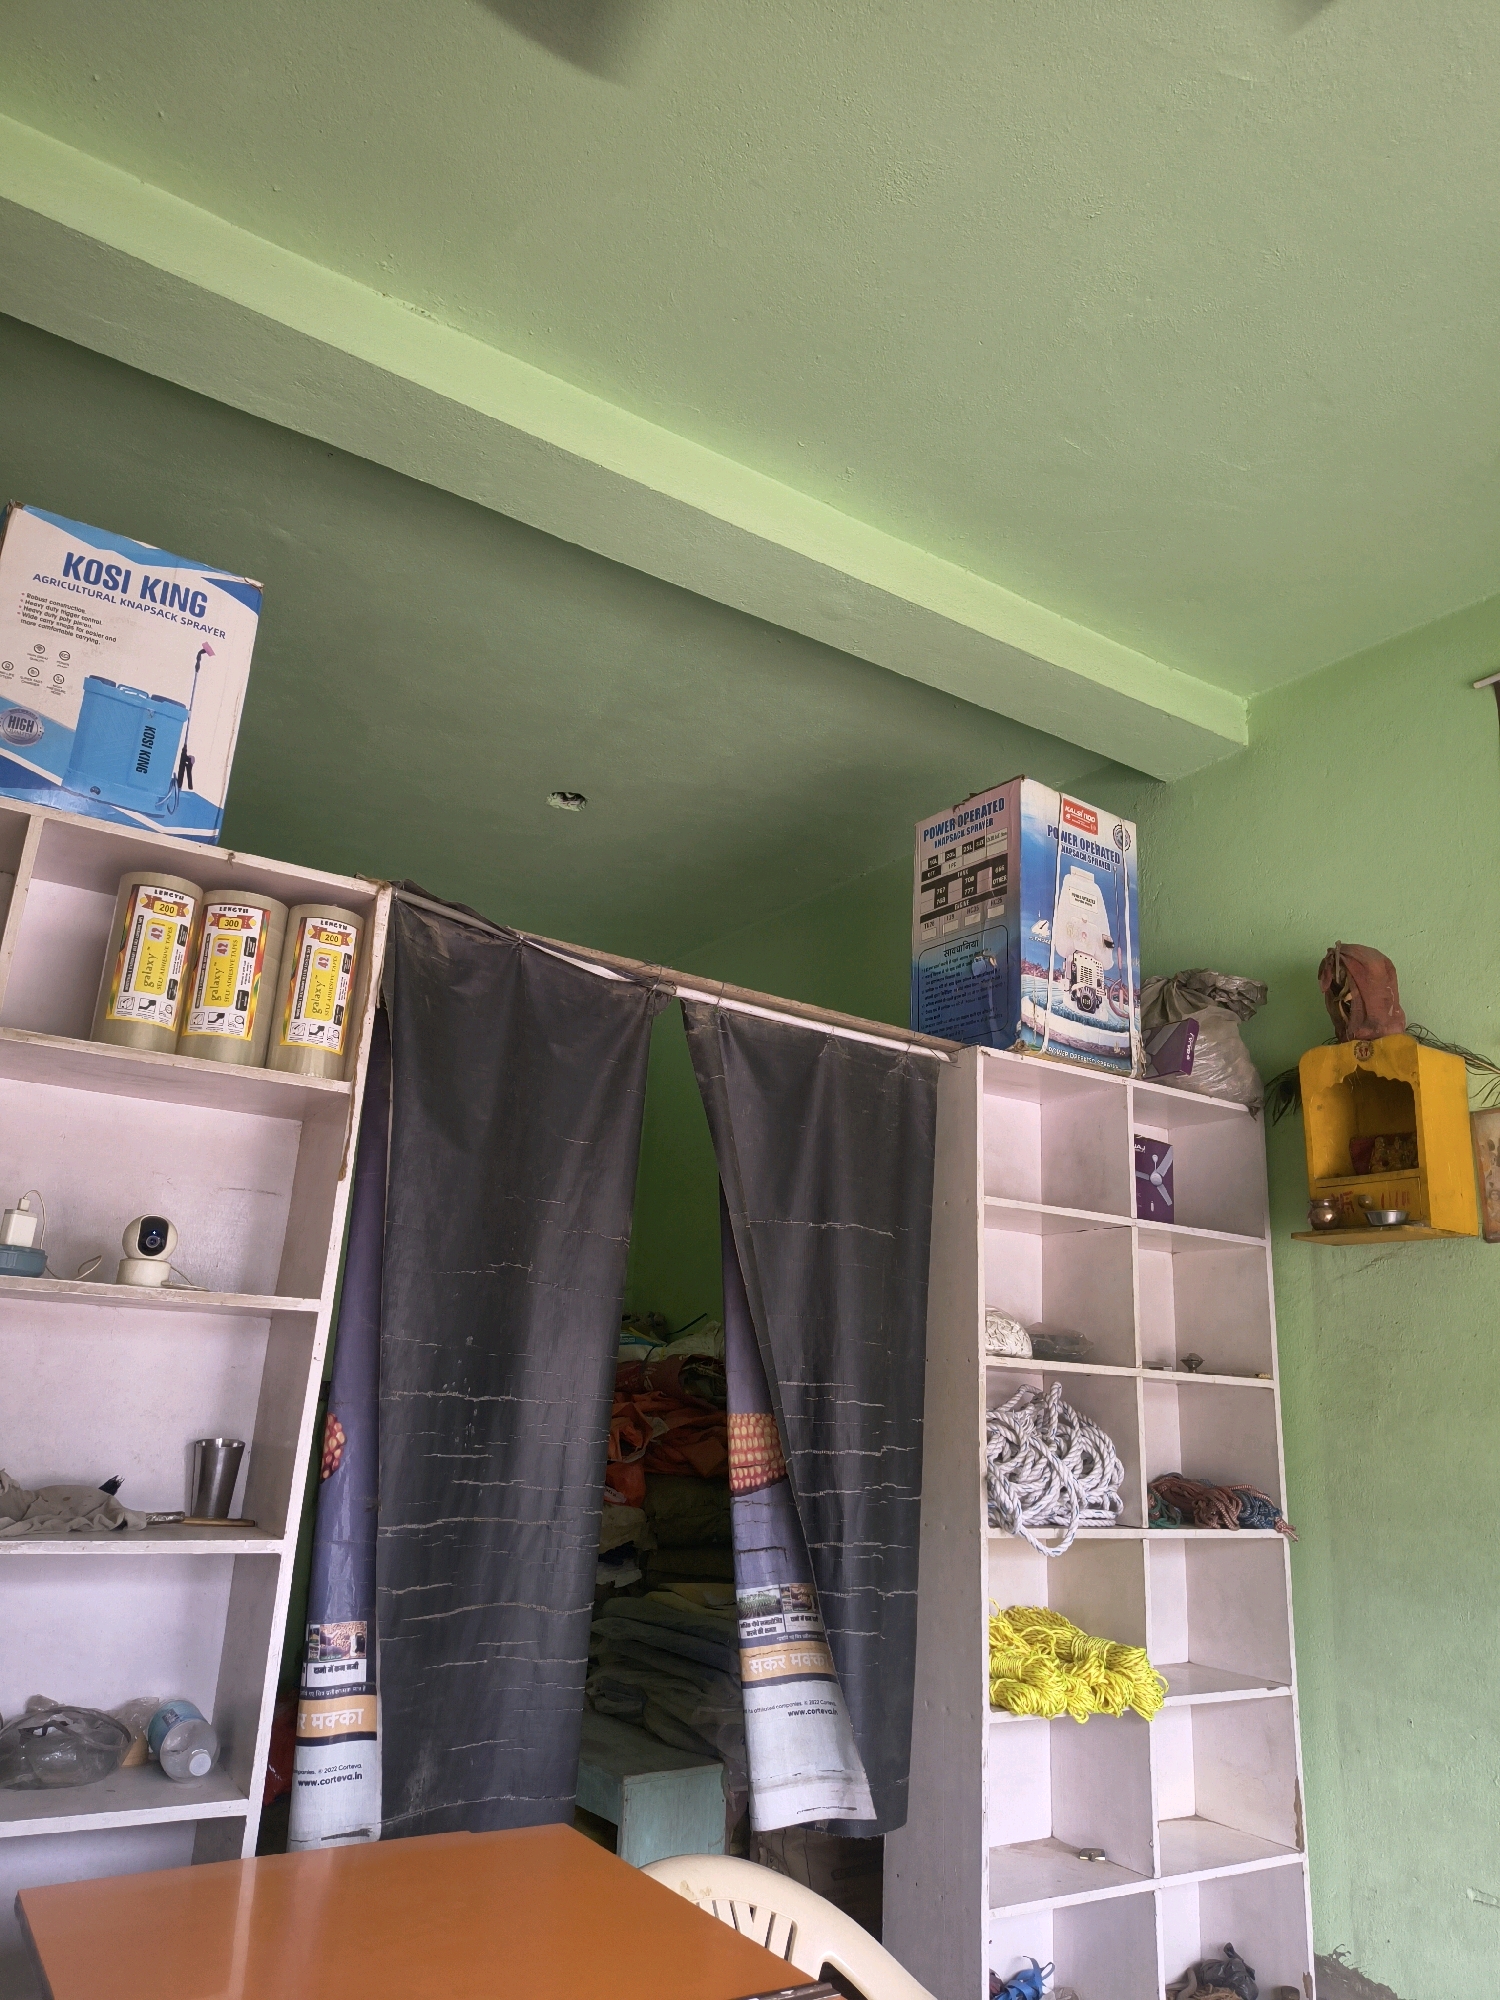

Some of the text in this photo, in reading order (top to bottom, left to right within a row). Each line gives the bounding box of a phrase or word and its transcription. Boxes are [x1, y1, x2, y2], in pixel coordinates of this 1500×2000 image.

[62, 551, 208, 619] KOSI KING
[23, 605, 42, 616] Heavy
[24, 599, 44, 610] Heavy
[32, 573, 226, 640] AGRICULTURAL KNAPSACK SPRAYER
[20, 618, 37, 627] more
[22, 611, 38, 621] Wide
[104, 634, 117, 643] and
[7, 715, 35, 733] HIGH
[135, 725, 157, 774] KOSI KING
[923, 817, 956, 842] POWER
[957, 797, 1005, 828] OPERATED
[934, 830, 965, 849] KNAPSACK
[966, 818, 994, 836] SPRAYER
[1079, 837, 1121, 865] OPERATED
[1087, 855, 1111, 872] SPRAYER
[153, 888, 185, 901] LENGTH
[158, 903, 175, 914] 200
[219, 906, 249, 914] LENGTH
[224, 919, 239, 928] 300
[320, 919, 348, 930] LENGTH
[150, 927, 163, 940] 42
[324, 933, 339, 943] 200
[216, 942, 229, 955] 42
[230, 939, 239, 958] TAPES
[156, 926, 173, 990] SELF ADHESIVE TAPES
[317, 956, 330, 969] 42
[141, 952, 158, 988] galaxy
[226, 959, 235, 988] ADHESIVE
[210, 966, 225, 1001] galaxy
[311, 980, 326, 1015] galaxy
[311, 1708, 364, 1730] मक्का
[323, 1765, 338, 1774] 2022
[297, 1771, 363, 1787] www.corteva.in
